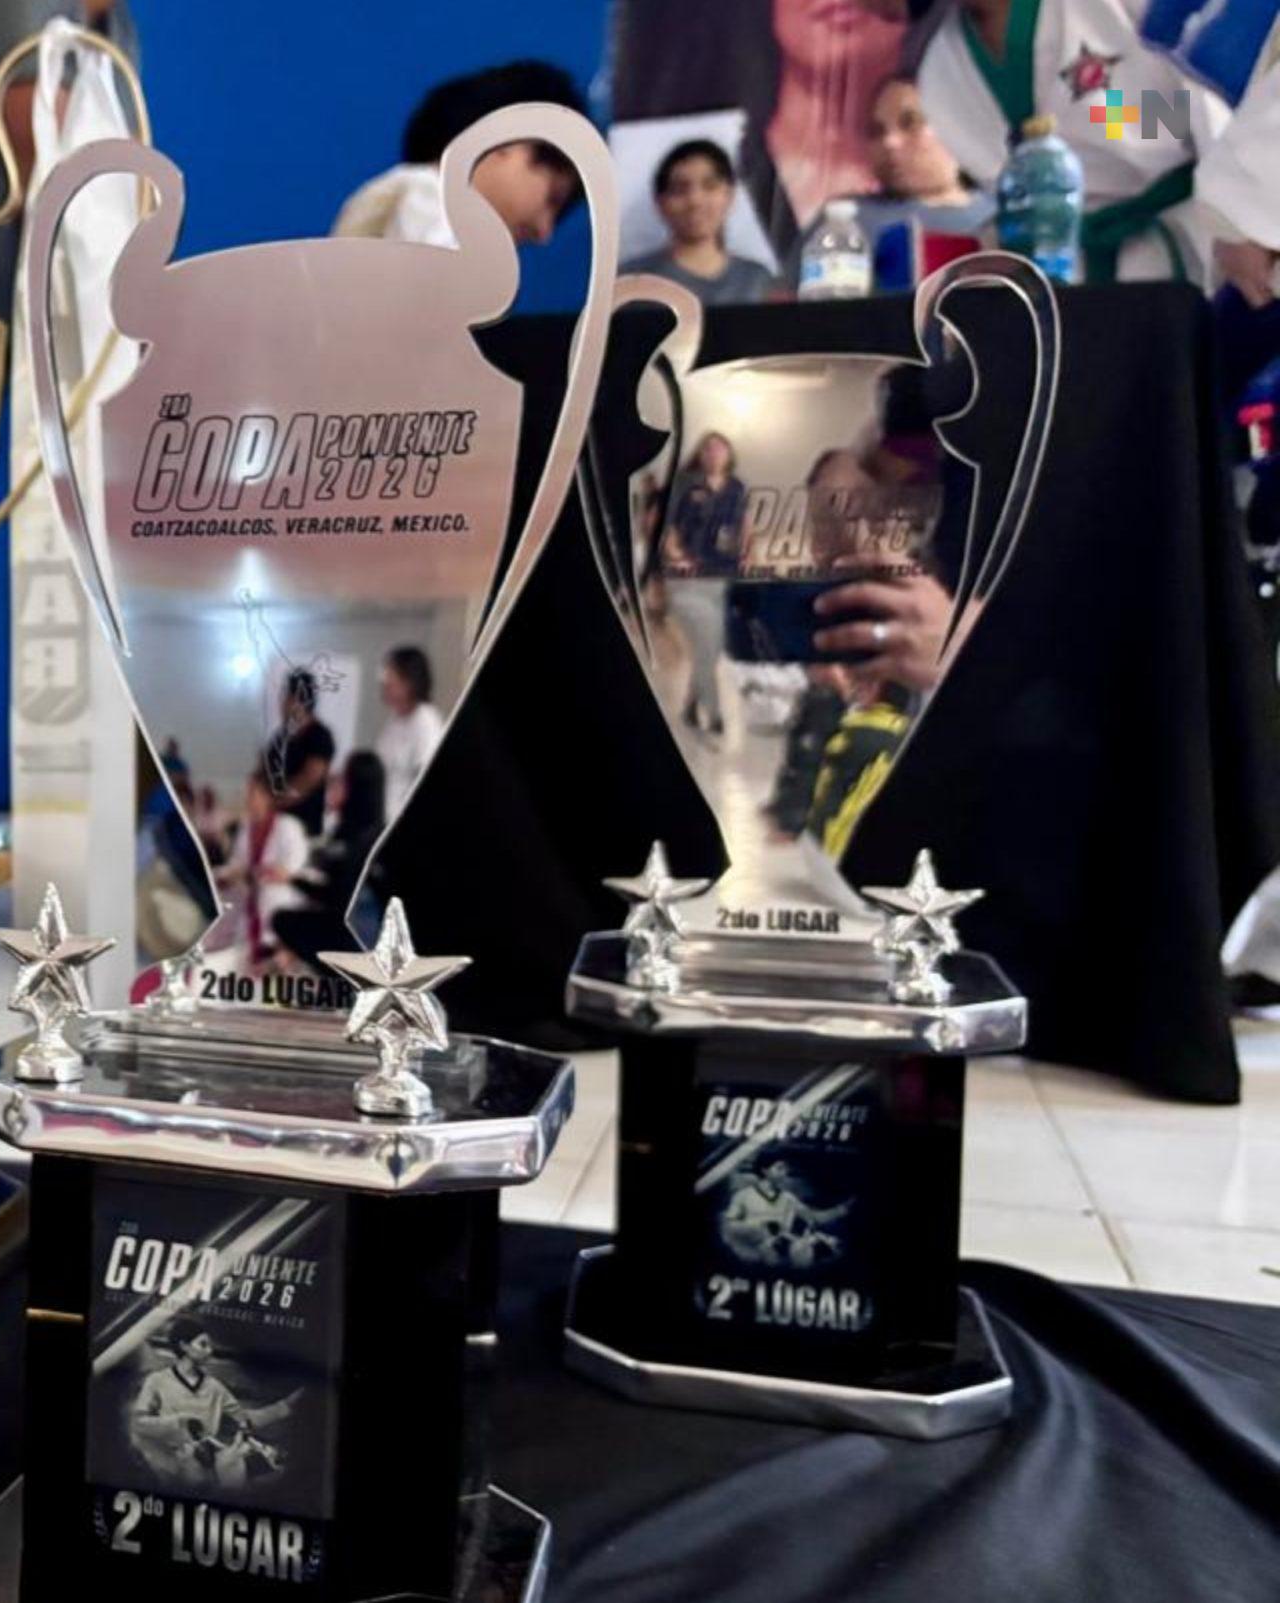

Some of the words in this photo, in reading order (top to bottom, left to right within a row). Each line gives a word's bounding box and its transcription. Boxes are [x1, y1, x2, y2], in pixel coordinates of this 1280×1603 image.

[133, 413, 318, 513] COPA
[317, 410, 479, 459] PONIENTE
[315, 455, 442, 501] 2026
[131, 519, 277, 538] COATZACOALCOS,
[285, 516, 384, 535] VERACRUZ,
[765, 908, 840, 934] LUGAR
[200, 969, 255, 1003] 2do
[104, 1234, 219, 1302] COPA
[218, 1275, 298, 1309] 2026
[111, 1490, 164, 1554] 2do
